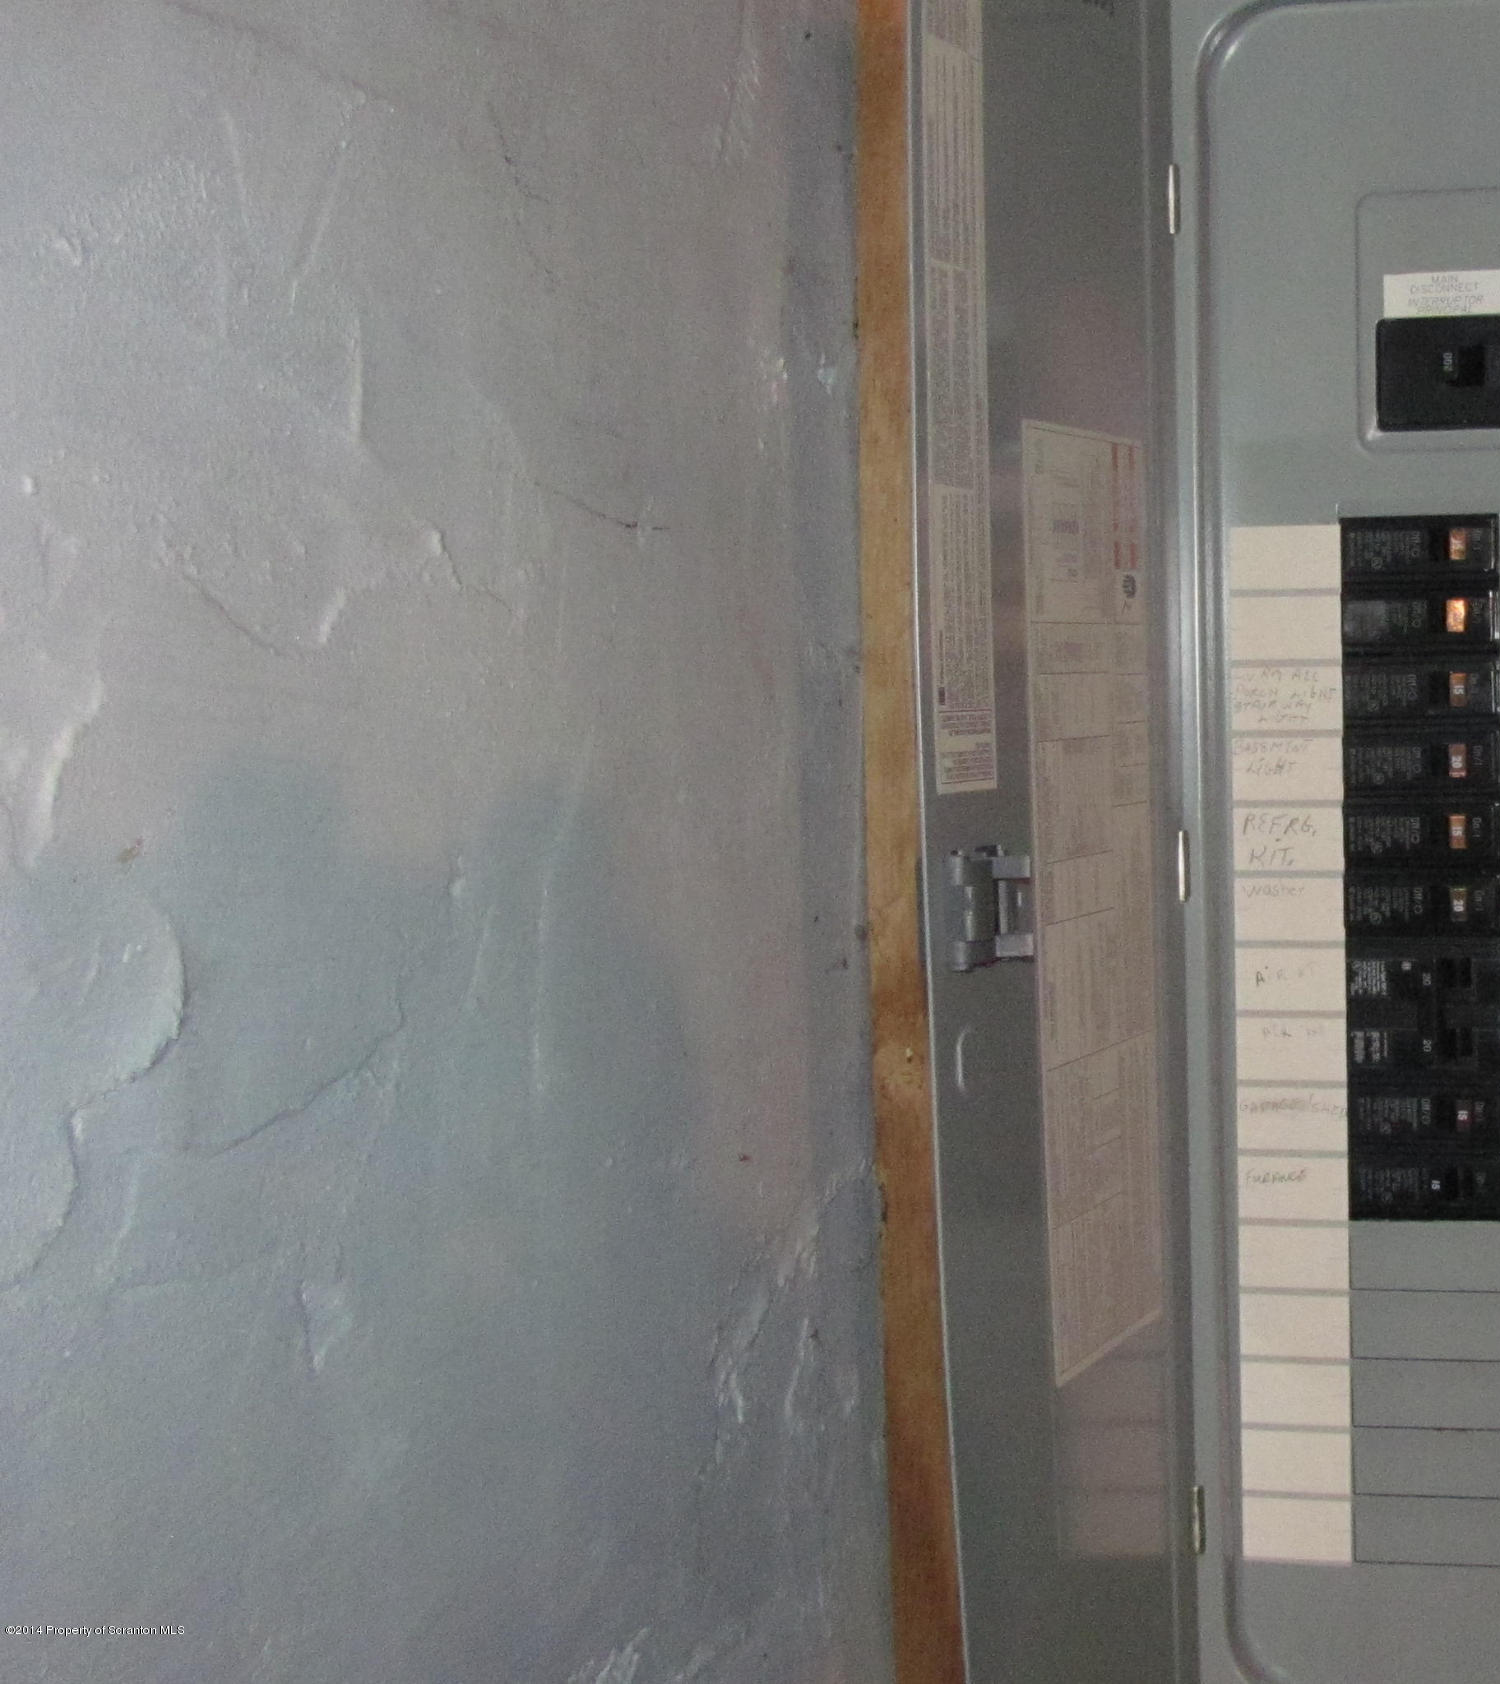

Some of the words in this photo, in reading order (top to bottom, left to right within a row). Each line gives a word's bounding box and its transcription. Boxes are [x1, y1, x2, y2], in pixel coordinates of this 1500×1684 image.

[1431, 275, 1458, 284] MAIN
[1410, 281, 1478, 295] DISCONNECT
[1453, 684, 1464, 695] 15
[1451, 755, 1462, 769] 20
[1452, 826, 1463, 837] 15
[1453, 899, 1464, 912] 20
[1422, 972, 1432, 987] 20
[1422, 1039, 1432, 1053] 20
[1457, 1109, 1468, 1121] 15
[1431, 1180, 1441, 1190] 15
